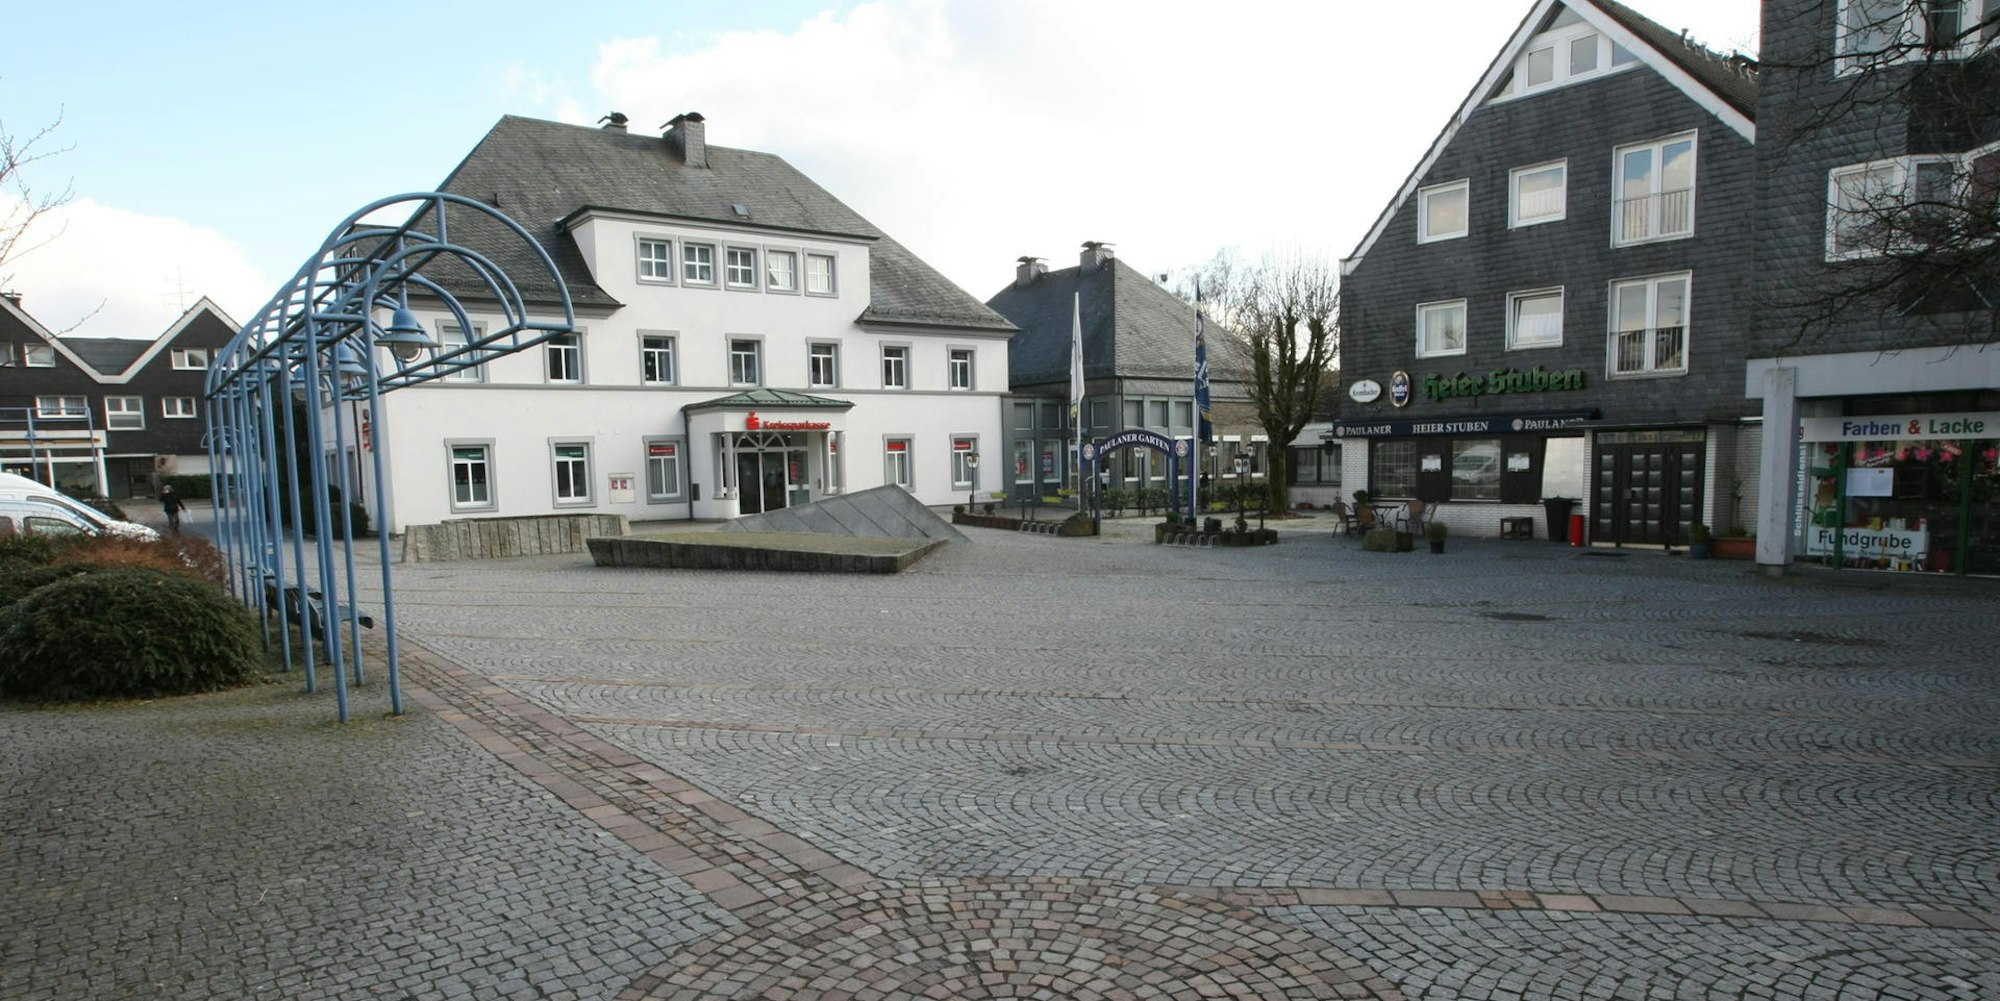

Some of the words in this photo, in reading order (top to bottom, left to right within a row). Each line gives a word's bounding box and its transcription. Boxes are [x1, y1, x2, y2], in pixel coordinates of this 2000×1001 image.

[1487, 365, 1583, 394] Stuben
[1346, 425, 1392, 435] PAULANER
[1412, 423, 1444, 433] HEIER
[1446, 421, 1489, 432] STUBEN
[1525, 417, 1584, 430] PAULAN
[1842, 421, 1900, 436] Farben
[1908, 419, 1921, 434] &
[1929, 418, 1984, 434] Lacke
[1100, 433, 1138, 454] PAULANER
[1138, 433, 1169, 452] GARTEN
